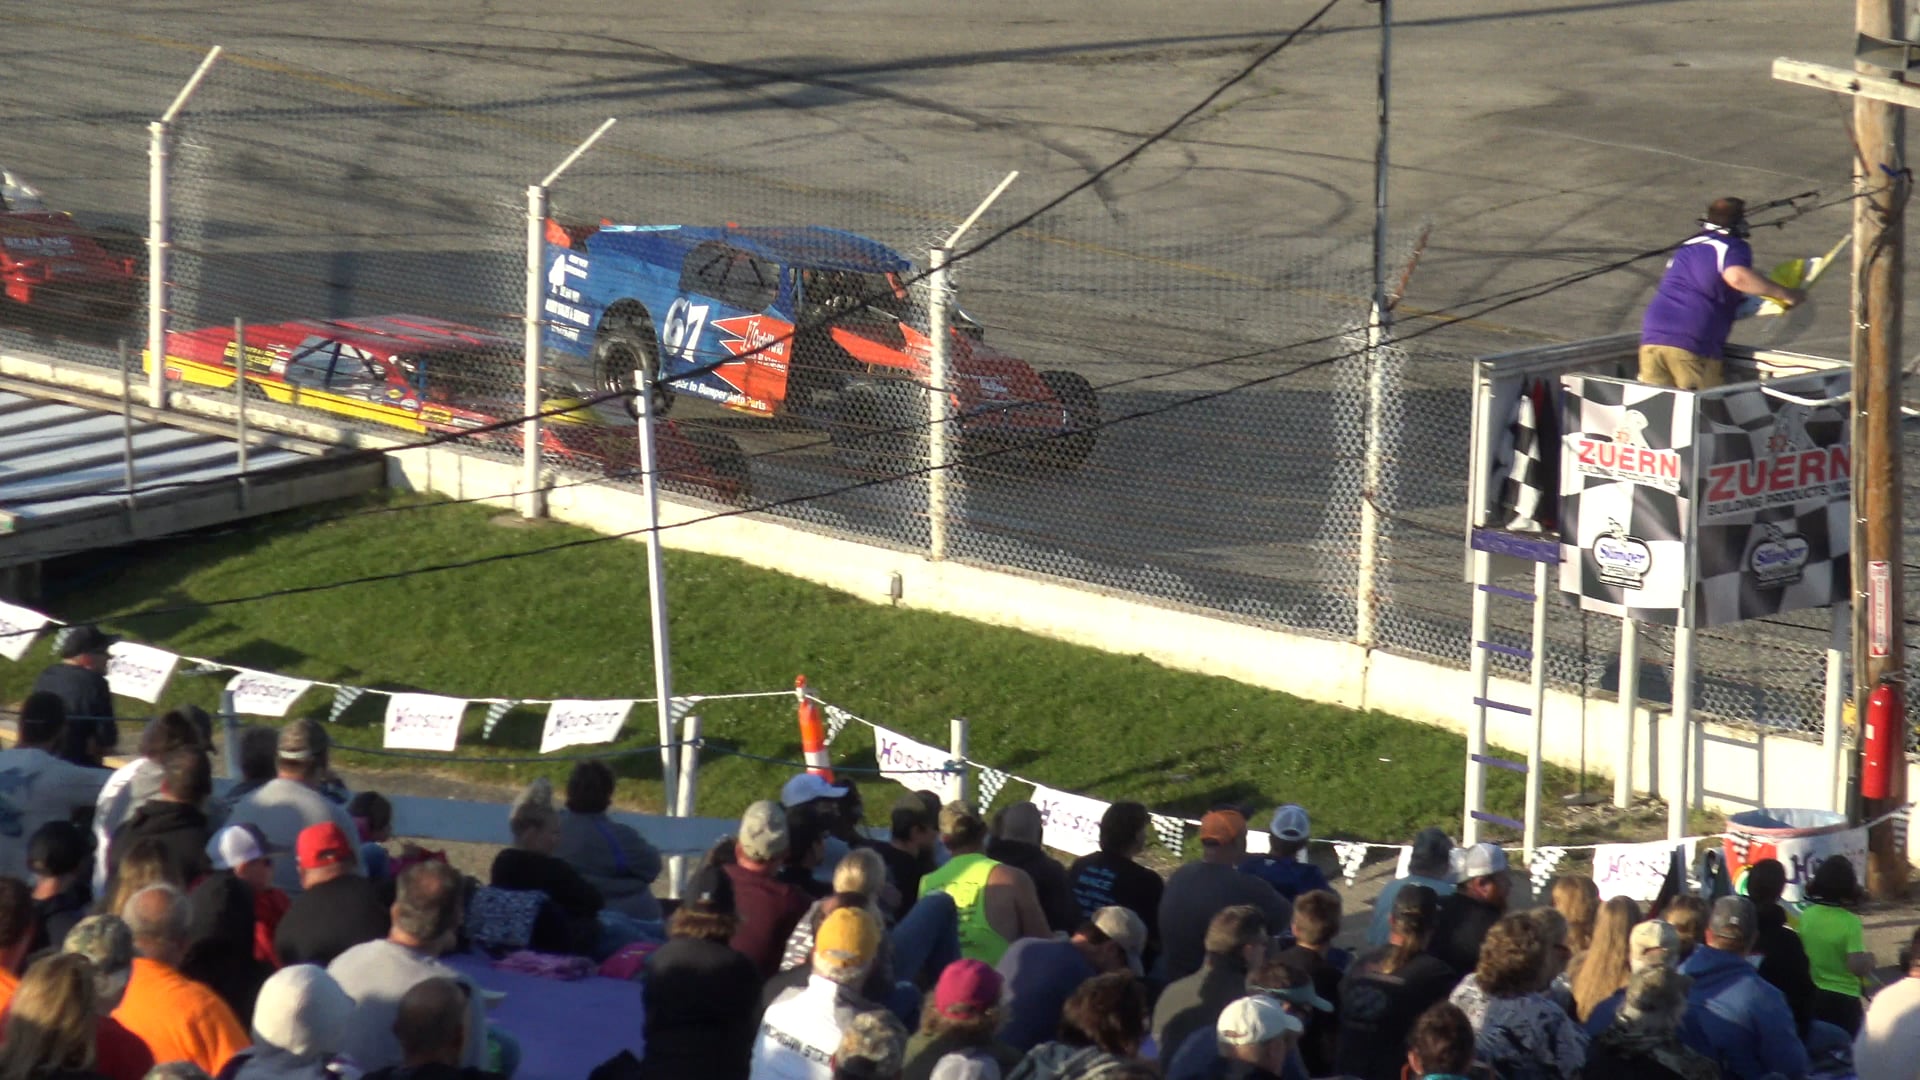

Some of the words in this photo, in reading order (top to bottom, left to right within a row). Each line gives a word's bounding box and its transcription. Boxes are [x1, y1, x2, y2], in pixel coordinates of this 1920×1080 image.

[663, 297, 709, 363] 67
[689, 378, 701, 392] to
[699, 378, 728, 402] Bumper
[727, 389, 747, 404] Auto
[747, 396, 767, 411] Parts
[1578, 440, 1678, 479] ZUERN
[1708, 447, 1850, 502] ZUERN
